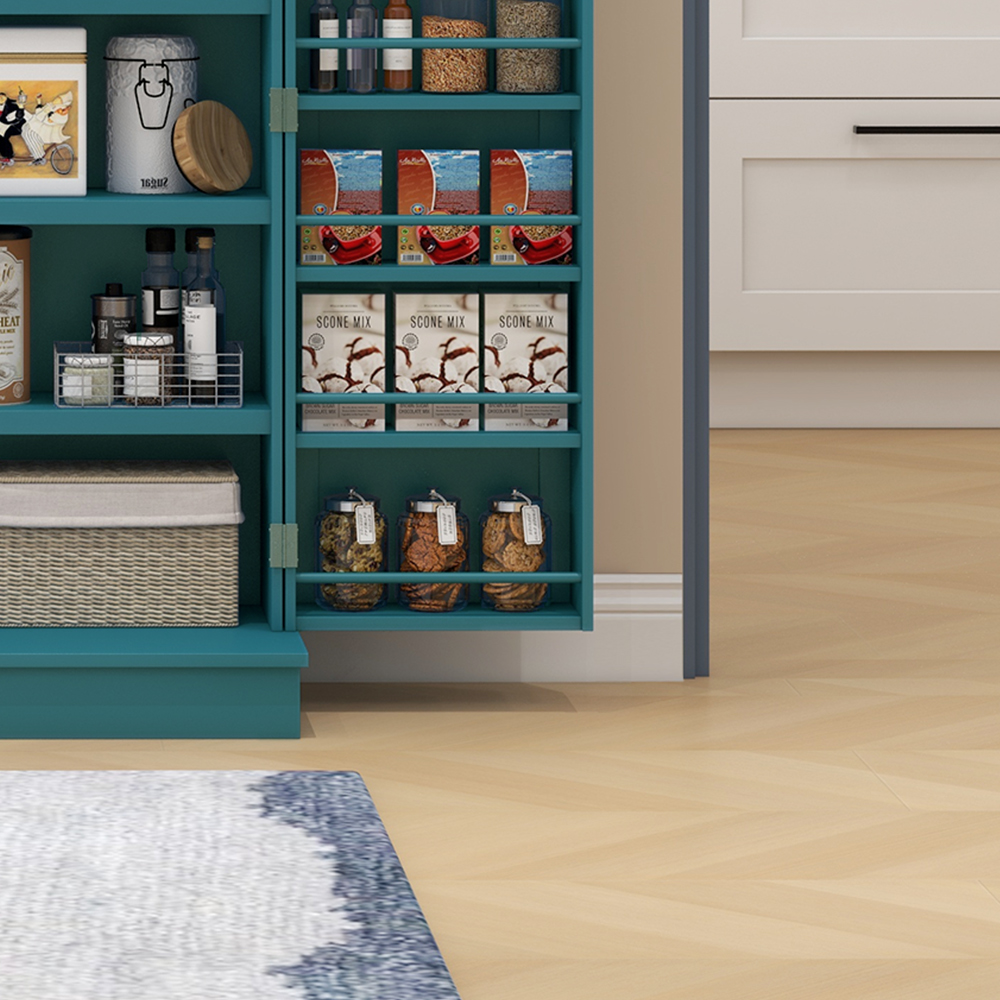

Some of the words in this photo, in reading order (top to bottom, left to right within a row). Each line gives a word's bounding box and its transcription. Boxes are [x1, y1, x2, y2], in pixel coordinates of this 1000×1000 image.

[316, 316, 348, 328] SCONE
[353, 316, 371, 328] MIX
[410, 316, 442, 328] SCONE
[447, 316, 465, 328] MIX
[499, 316, 531, 328] SCONE
[536, 316, 554, 328] MIX
